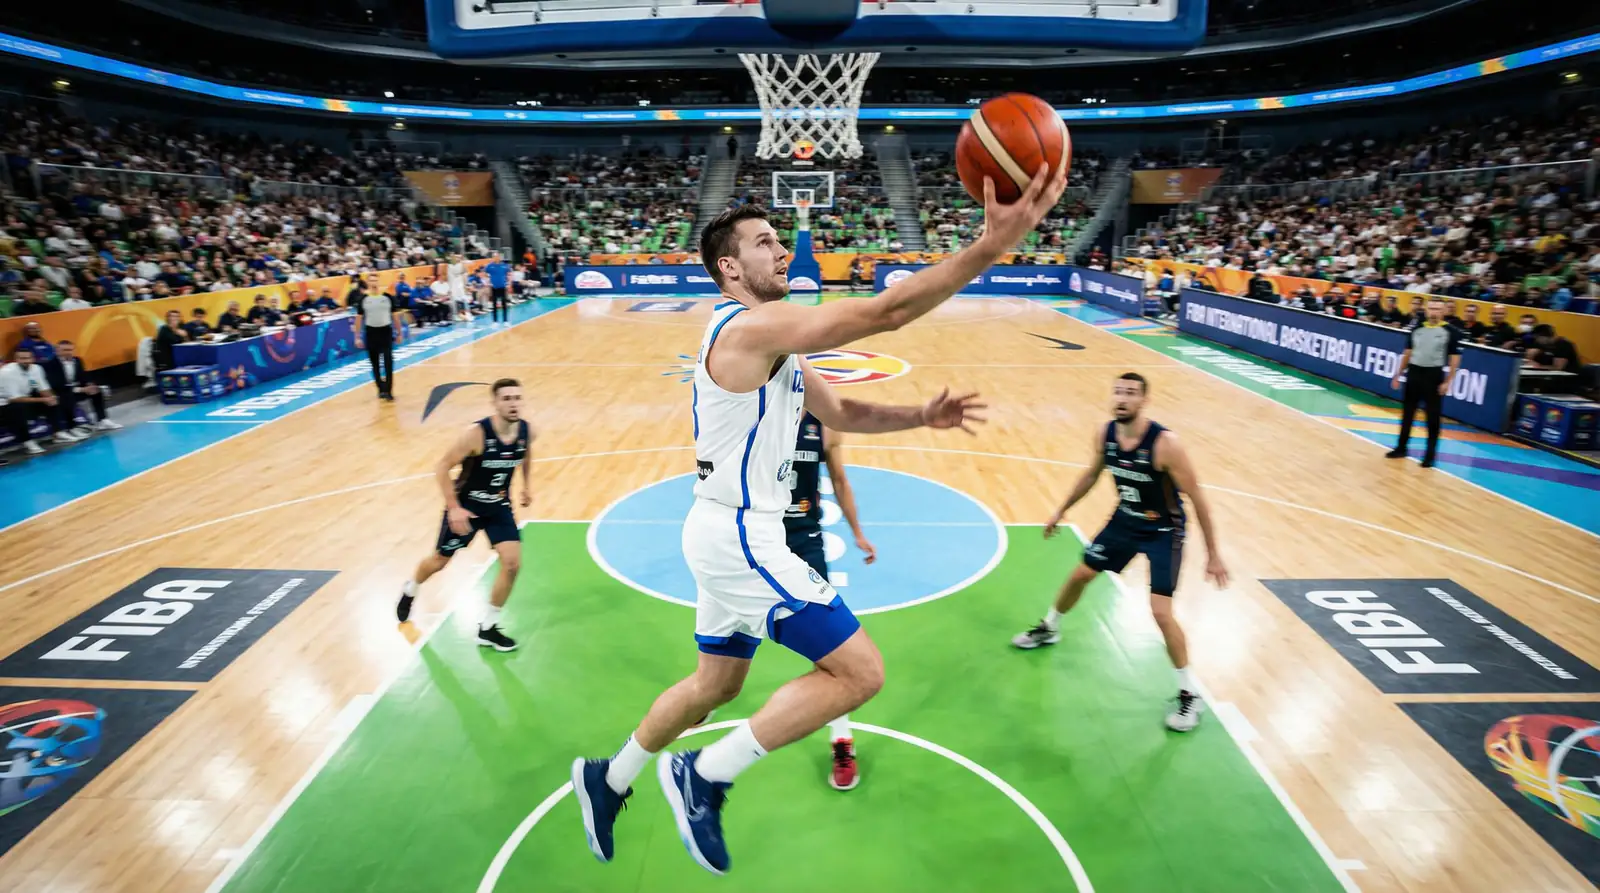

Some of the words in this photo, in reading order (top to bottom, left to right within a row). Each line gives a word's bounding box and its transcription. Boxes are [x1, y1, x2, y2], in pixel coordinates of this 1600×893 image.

[1280, 325, 1362, 369] BASKETBALL
[38, 579, 233, 661] FIBA
[1304, 590, 1481, 674] FIBA
